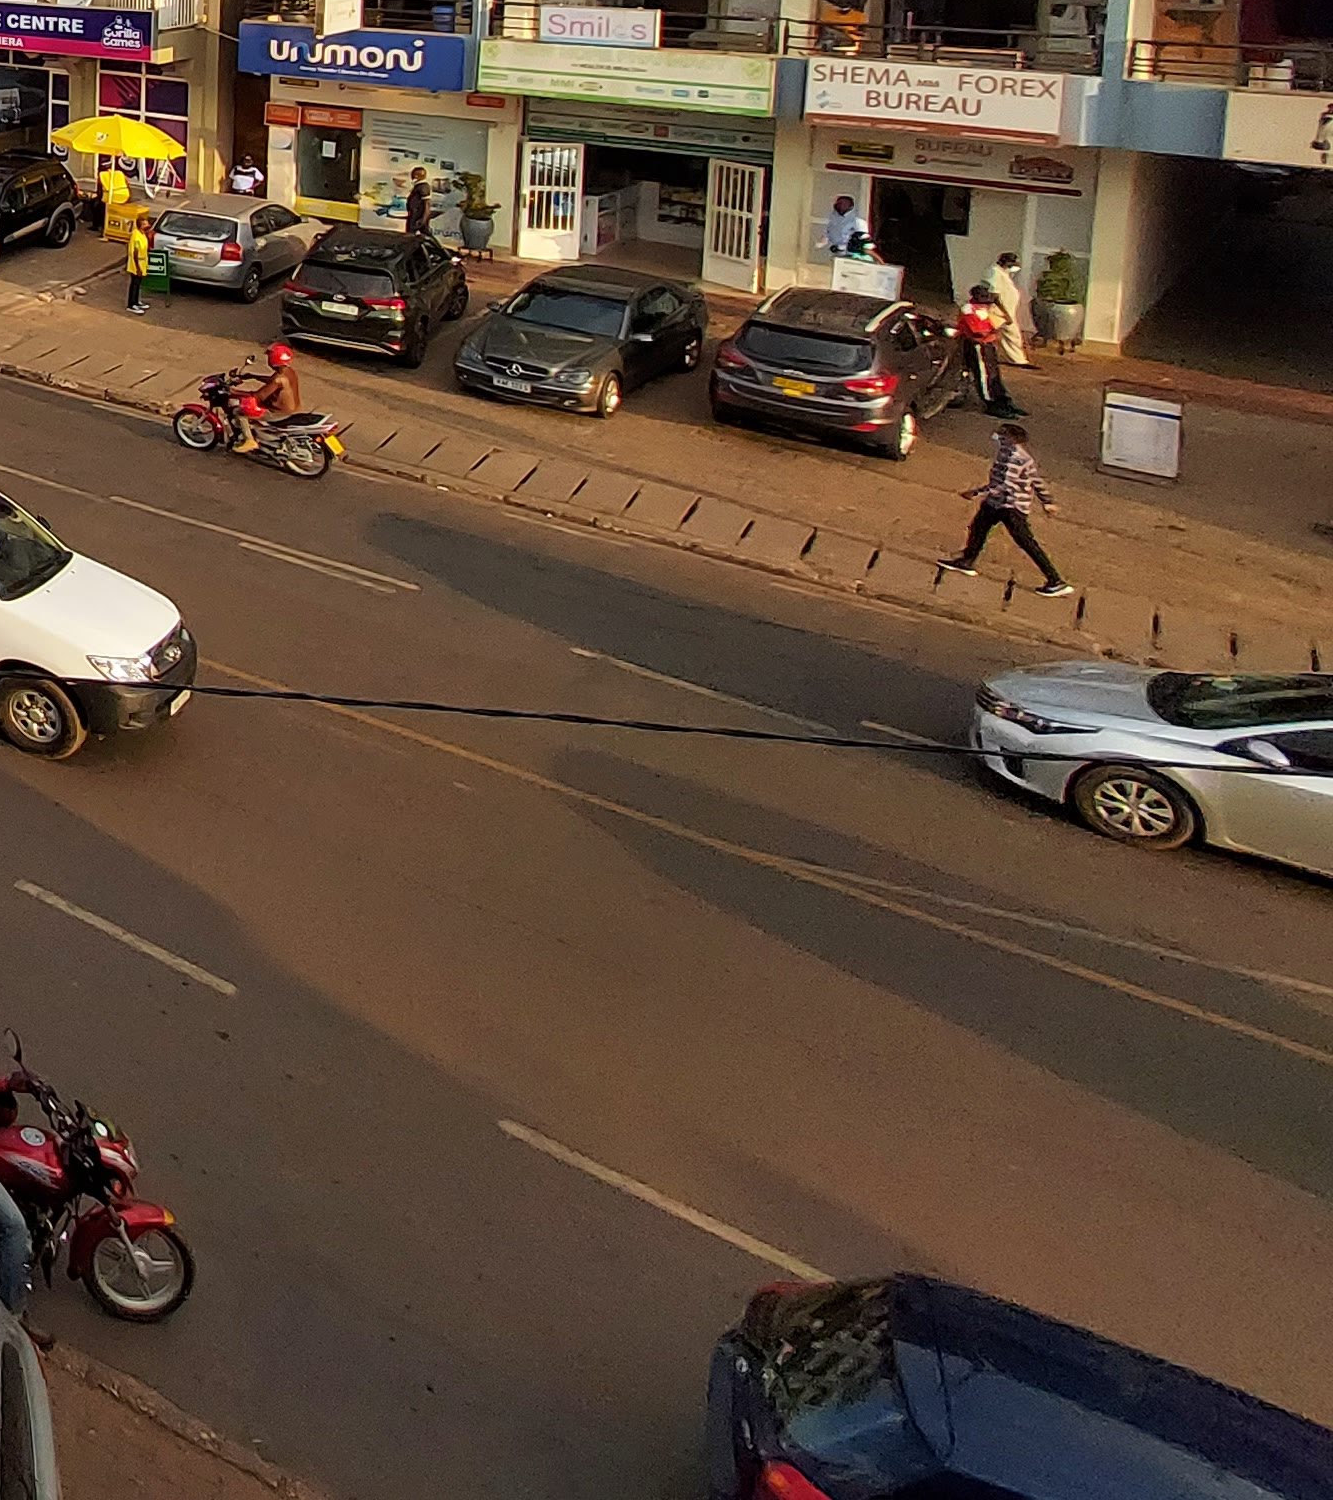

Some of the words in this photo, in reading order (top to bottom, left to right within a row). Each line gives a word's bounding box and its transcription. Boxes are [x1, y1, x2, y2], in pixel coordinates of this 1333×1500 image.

[6, 13, 85, 34] CENTRE
[103, 37, 141, 49] Games
[812, 63, 911, 88] SHEMA
[957, 73, 1059, 100] FOREX
[865, 90, 983, 117] BUREAU
